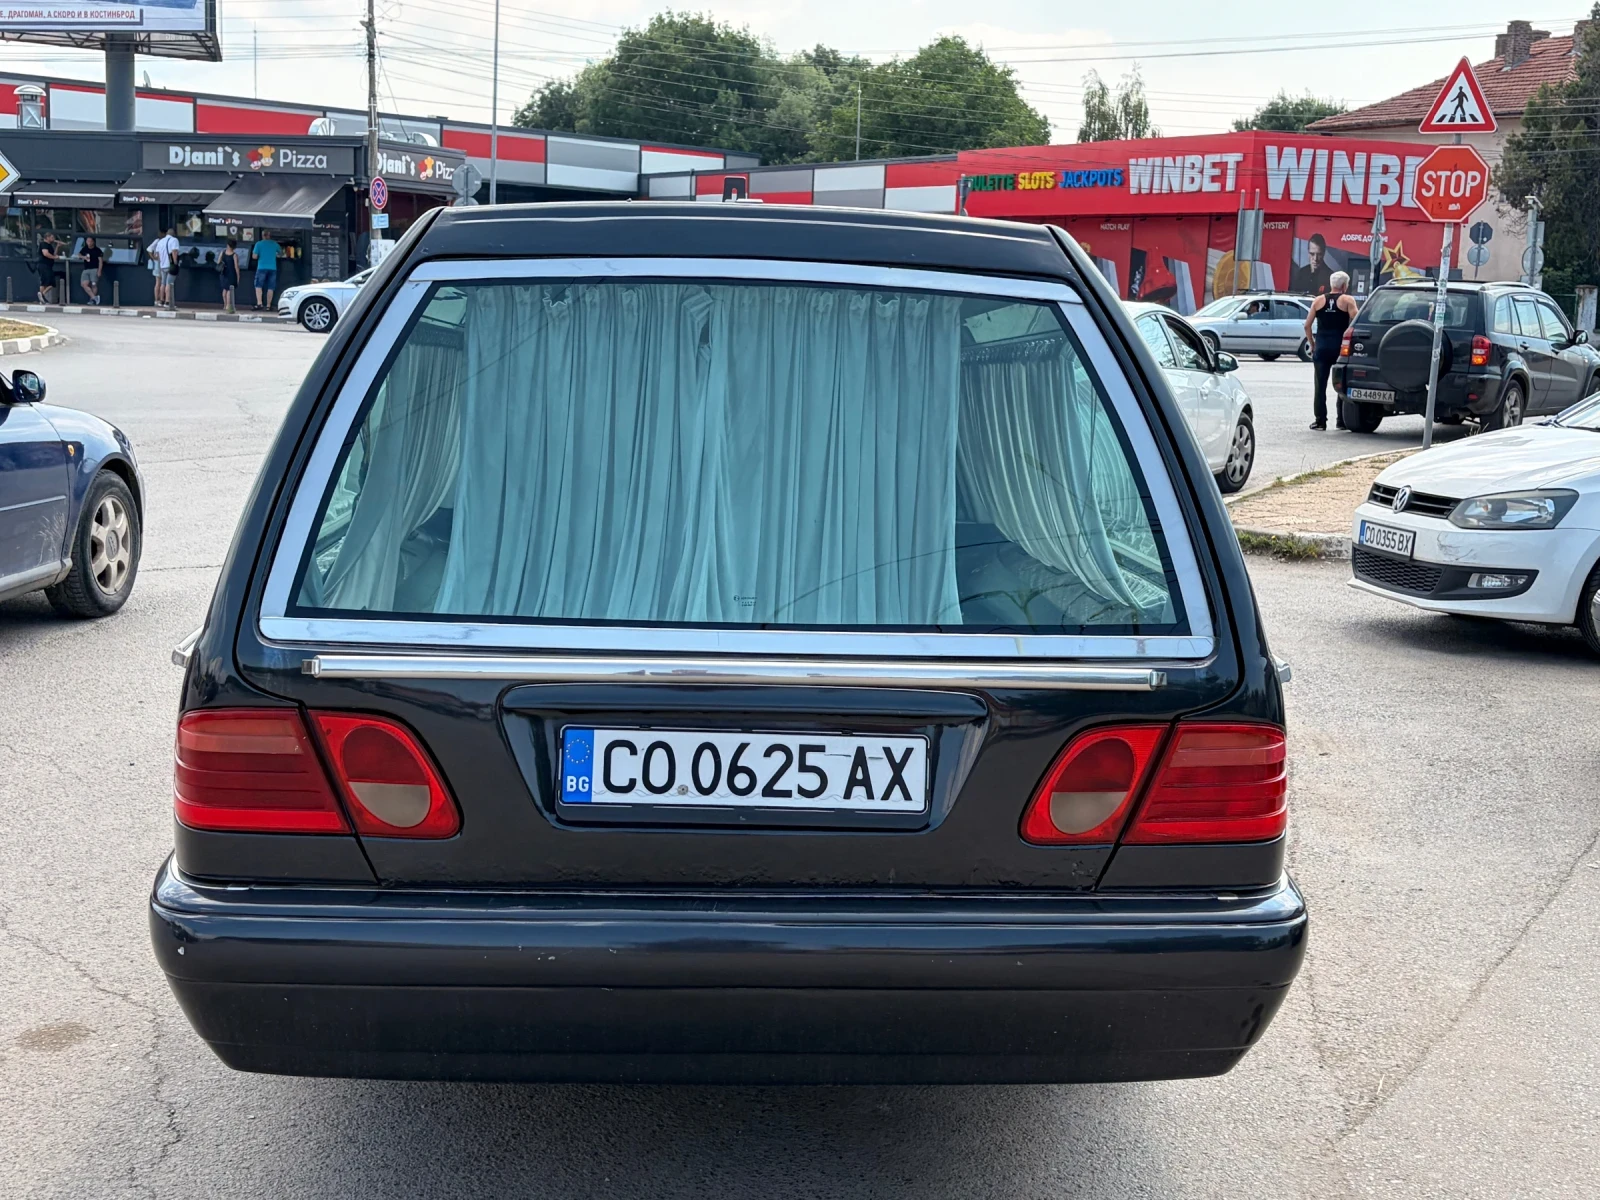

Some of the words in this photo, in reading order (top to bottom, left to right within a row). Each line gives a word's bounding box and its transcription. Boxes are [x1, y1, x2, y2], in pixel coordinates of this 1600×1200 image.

[8, 10, 46, 19] ДРАГОМАН,
[53, 10, 76, 18] СКОРО
[77, 10, 82, 18] И
[83, 10, 89, 18] В
[90, 10, 136, 20] КОСТИНБРОД
[279, 149, 327, 169] Pizza
[1017, 171, 1056, 190] SLOTS
[1058, 167, 1124, 189] JACKPOTS
[1128, 152, 1244, 195] WINBET
[1421, 169, 1481, 198] STOP
[1351, 389, 1362, 399] CB
[1363, 390, 1382, 400] 4489
[1382, 391, 1393, 401] KA
[1365, 525, 1375, 544] CO
[1376, 528, 1397, 550] 0355
[1397, 533, 1412, 554] BX
[602, 739, 676, 795] CO
[691, 741, 829, 800] 0625
[842, 745, 915, 801] AX
[566, 775, 590, 793] BG
